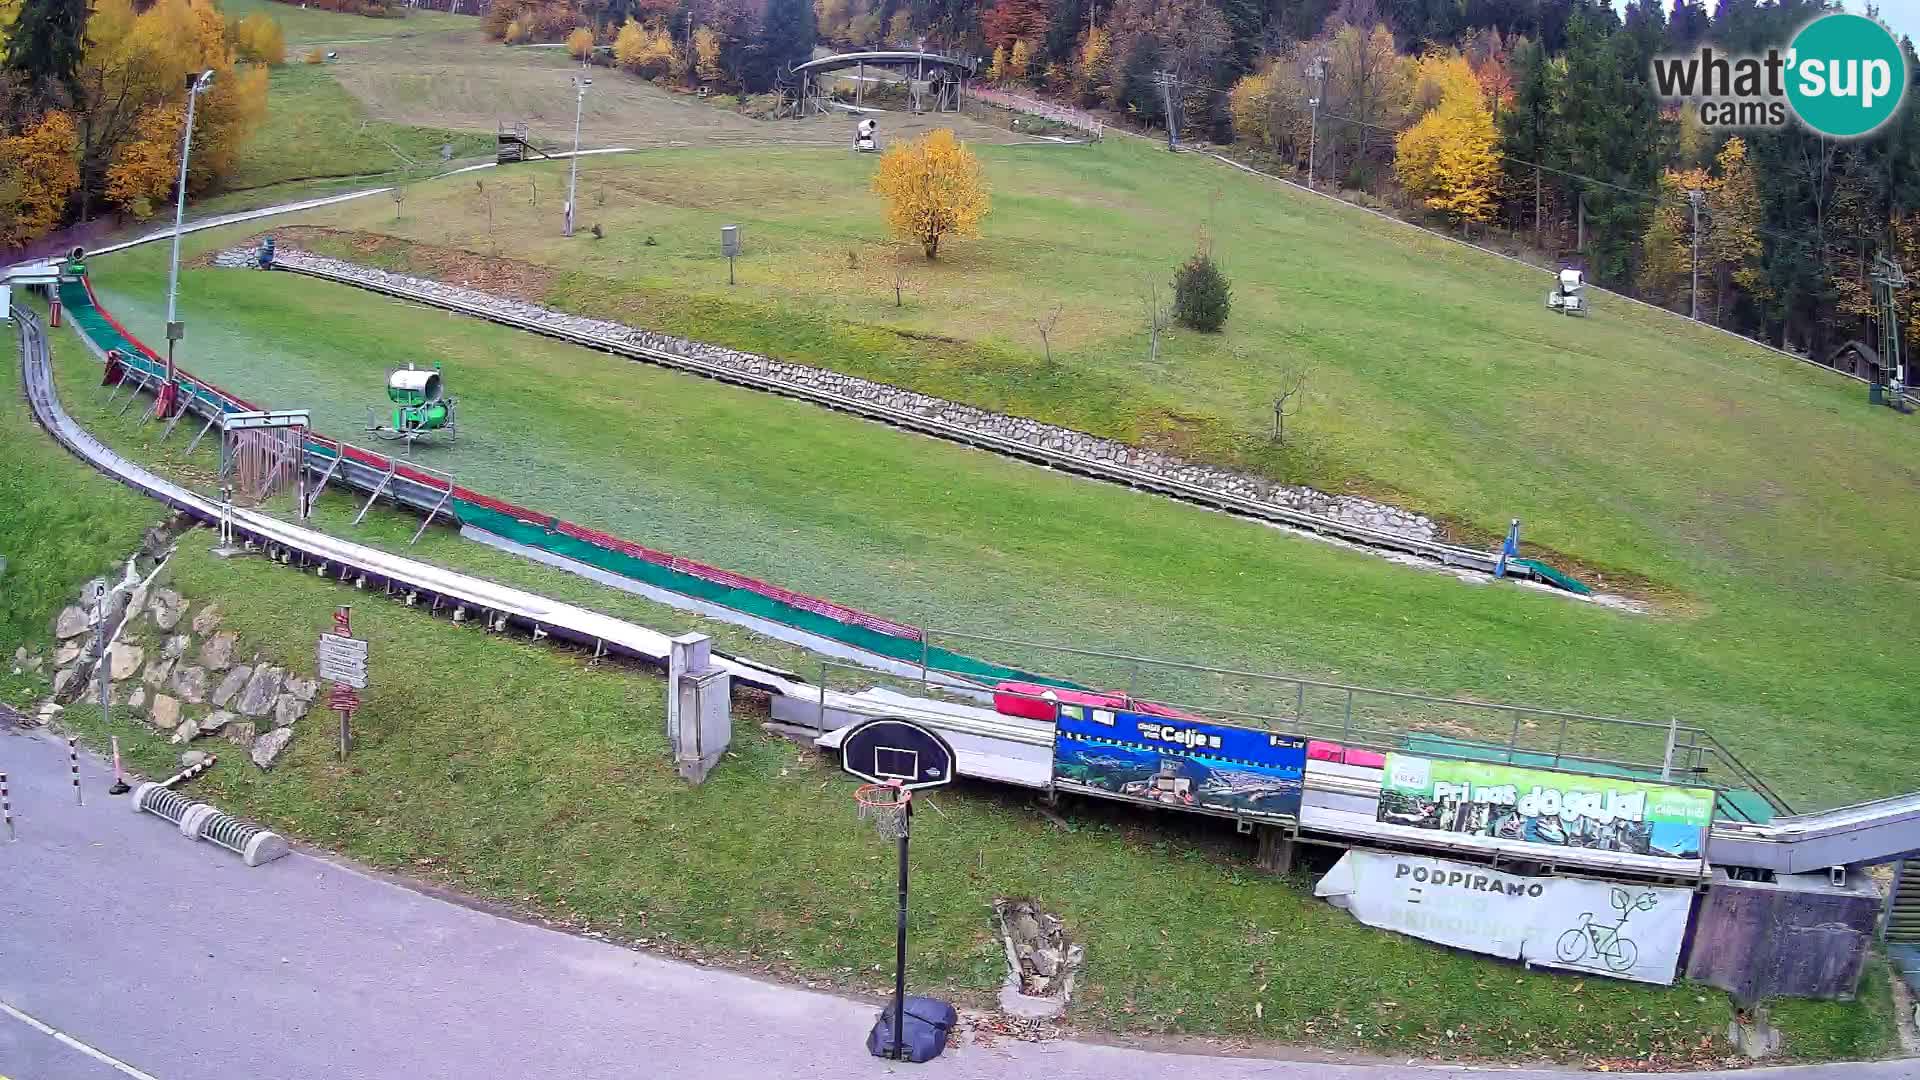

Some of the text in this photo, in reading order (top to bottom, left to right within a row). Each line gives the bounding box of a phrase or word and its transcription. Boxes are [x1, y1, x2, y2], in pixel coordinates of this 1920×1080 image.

[1161, 726, 1207, 748] Celje
[1433, 781, 1471, 803] Pri
[1395, 863, 1544, 898] PODPIRAMO
